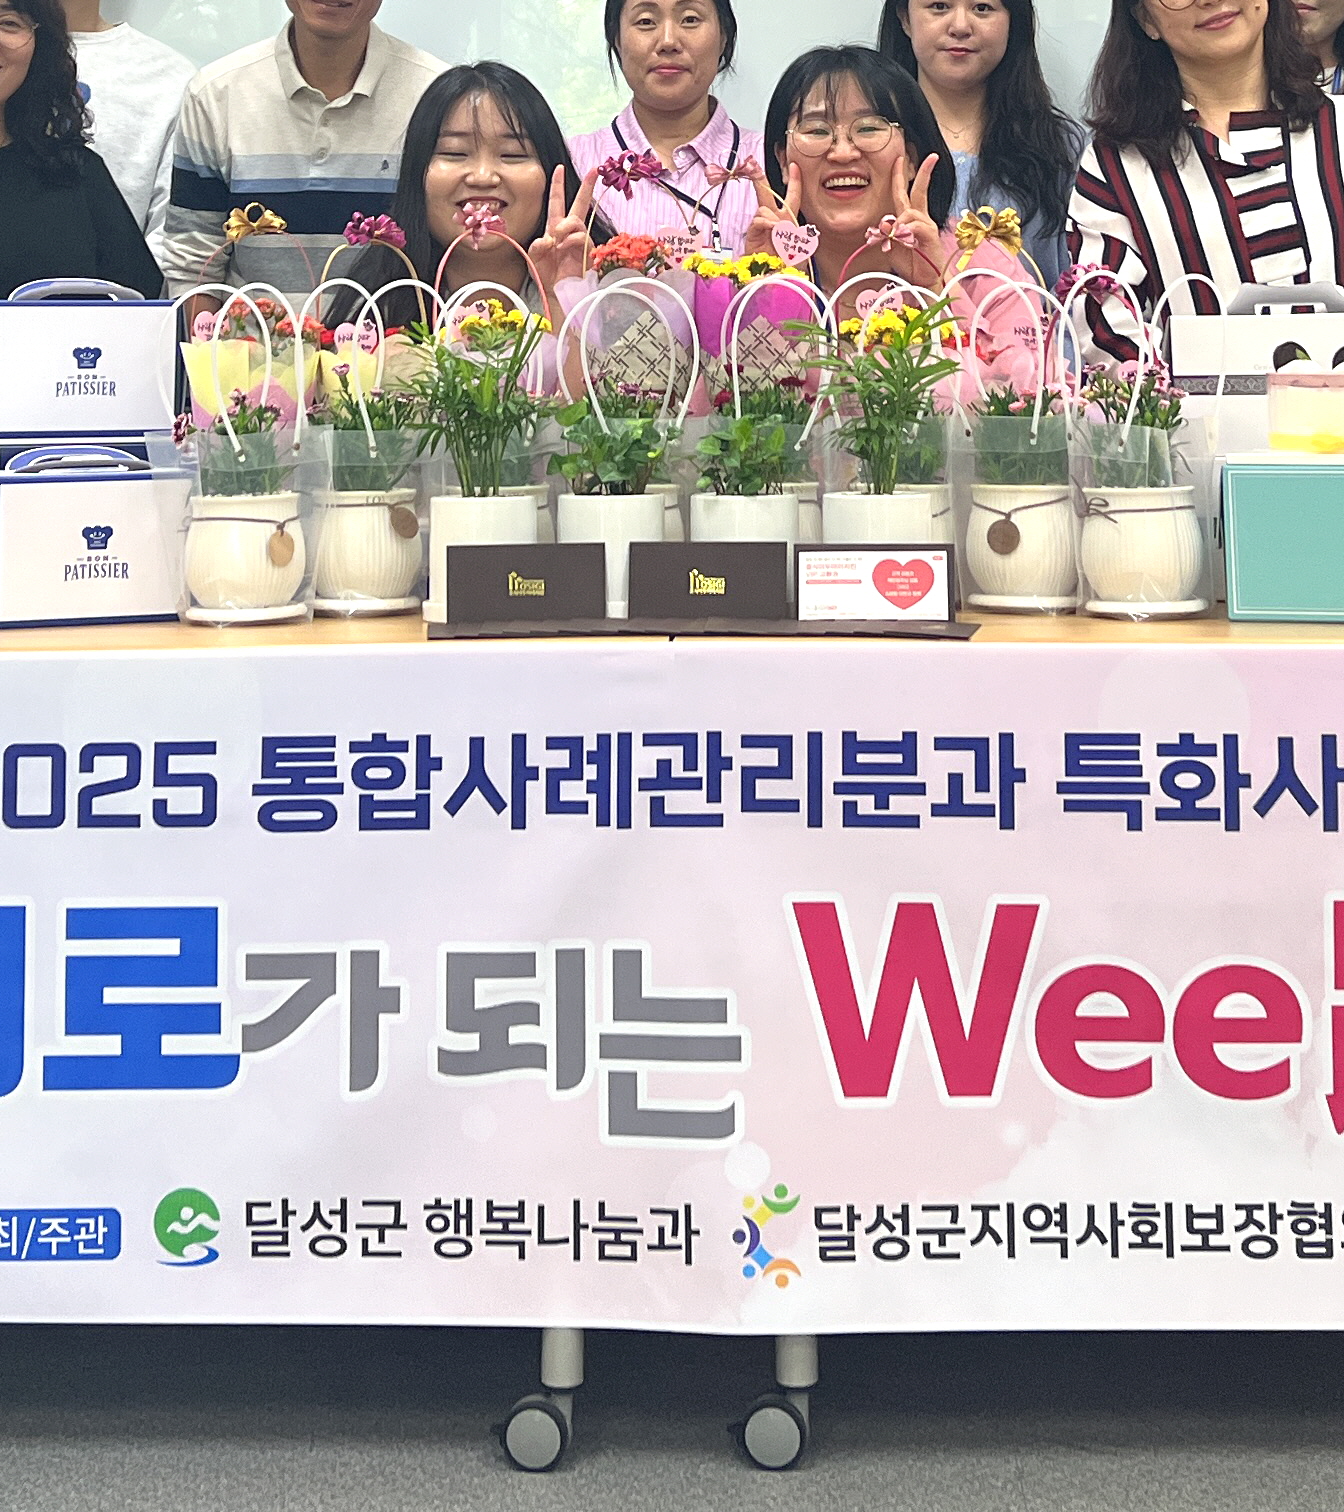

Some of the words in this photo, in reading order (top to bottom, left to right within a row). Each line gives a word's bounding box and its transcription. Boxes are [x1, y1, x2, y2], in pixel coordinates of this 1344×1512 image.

[55, 381, 117, 397] PATISSIER
[64, 562, 130, 582] PATISSIER
[251, 731, 1027, 834] 통합사례관리분과
[435, 946, 743, 1141] 되는
[244, 1197, 408, 1262] 달성군
[424, 1197, 700, 1266] 행복나눔과
